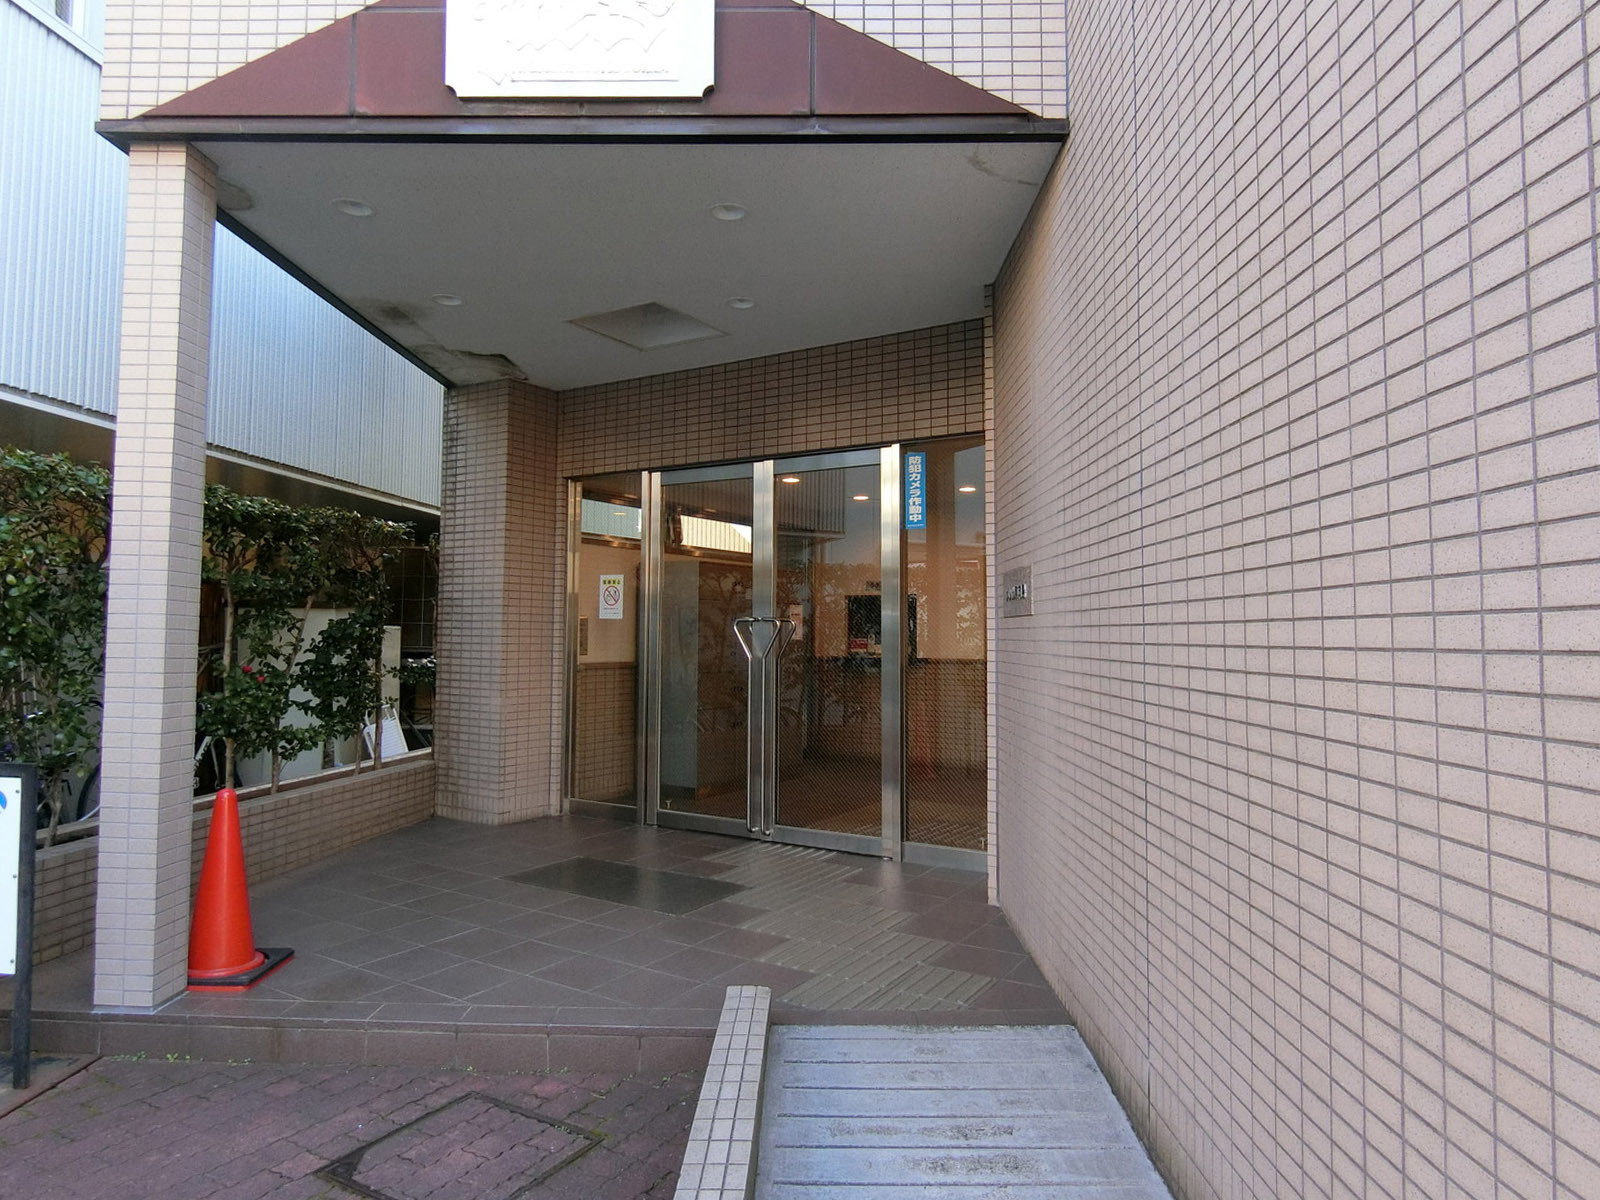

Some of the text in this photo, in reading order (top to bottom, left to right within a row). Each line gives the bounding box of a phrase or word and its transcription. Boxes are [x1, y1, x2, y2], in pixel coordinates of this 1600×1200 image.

[908, 456, 922, 522] 防犯カメラ作動中
